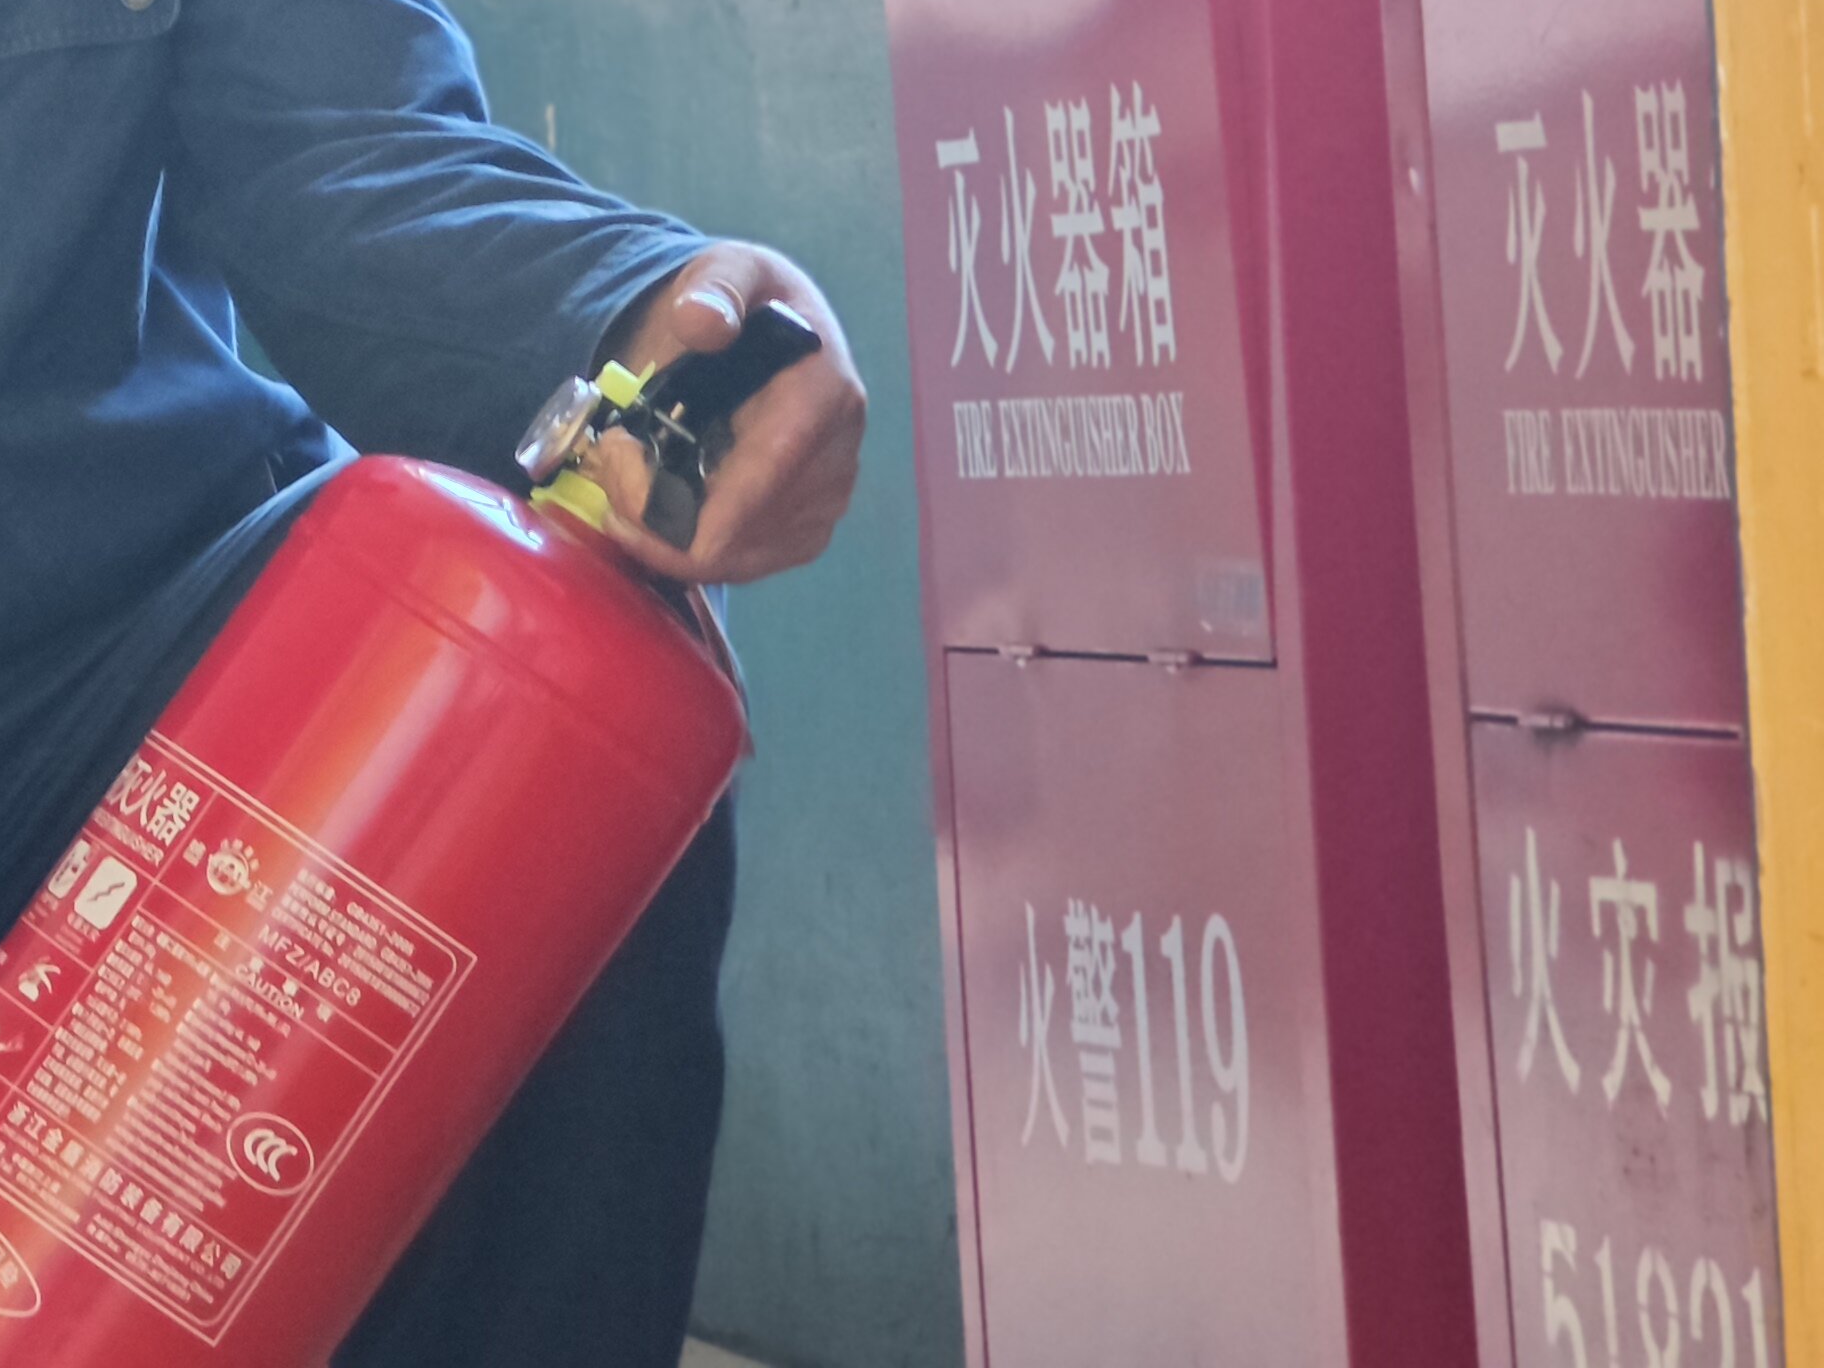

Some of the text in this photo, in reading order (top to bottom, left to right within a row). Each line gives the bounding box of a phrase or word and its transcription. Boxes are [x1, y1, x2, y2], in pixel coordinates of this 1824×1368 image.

[937, 80, 1176, 373] 灭火器箱
[953, 391, 1191, 478] FIRE EXTINGUISHER BOX
[1504, 408, 1731, 499] FIRE EXTINGUISHER
[231, 963, 306, 1020] CAUTION
[253, 923, 365, 1008] MFZ/ABC8
[1019, 898, 1249, 1183] 火警119
